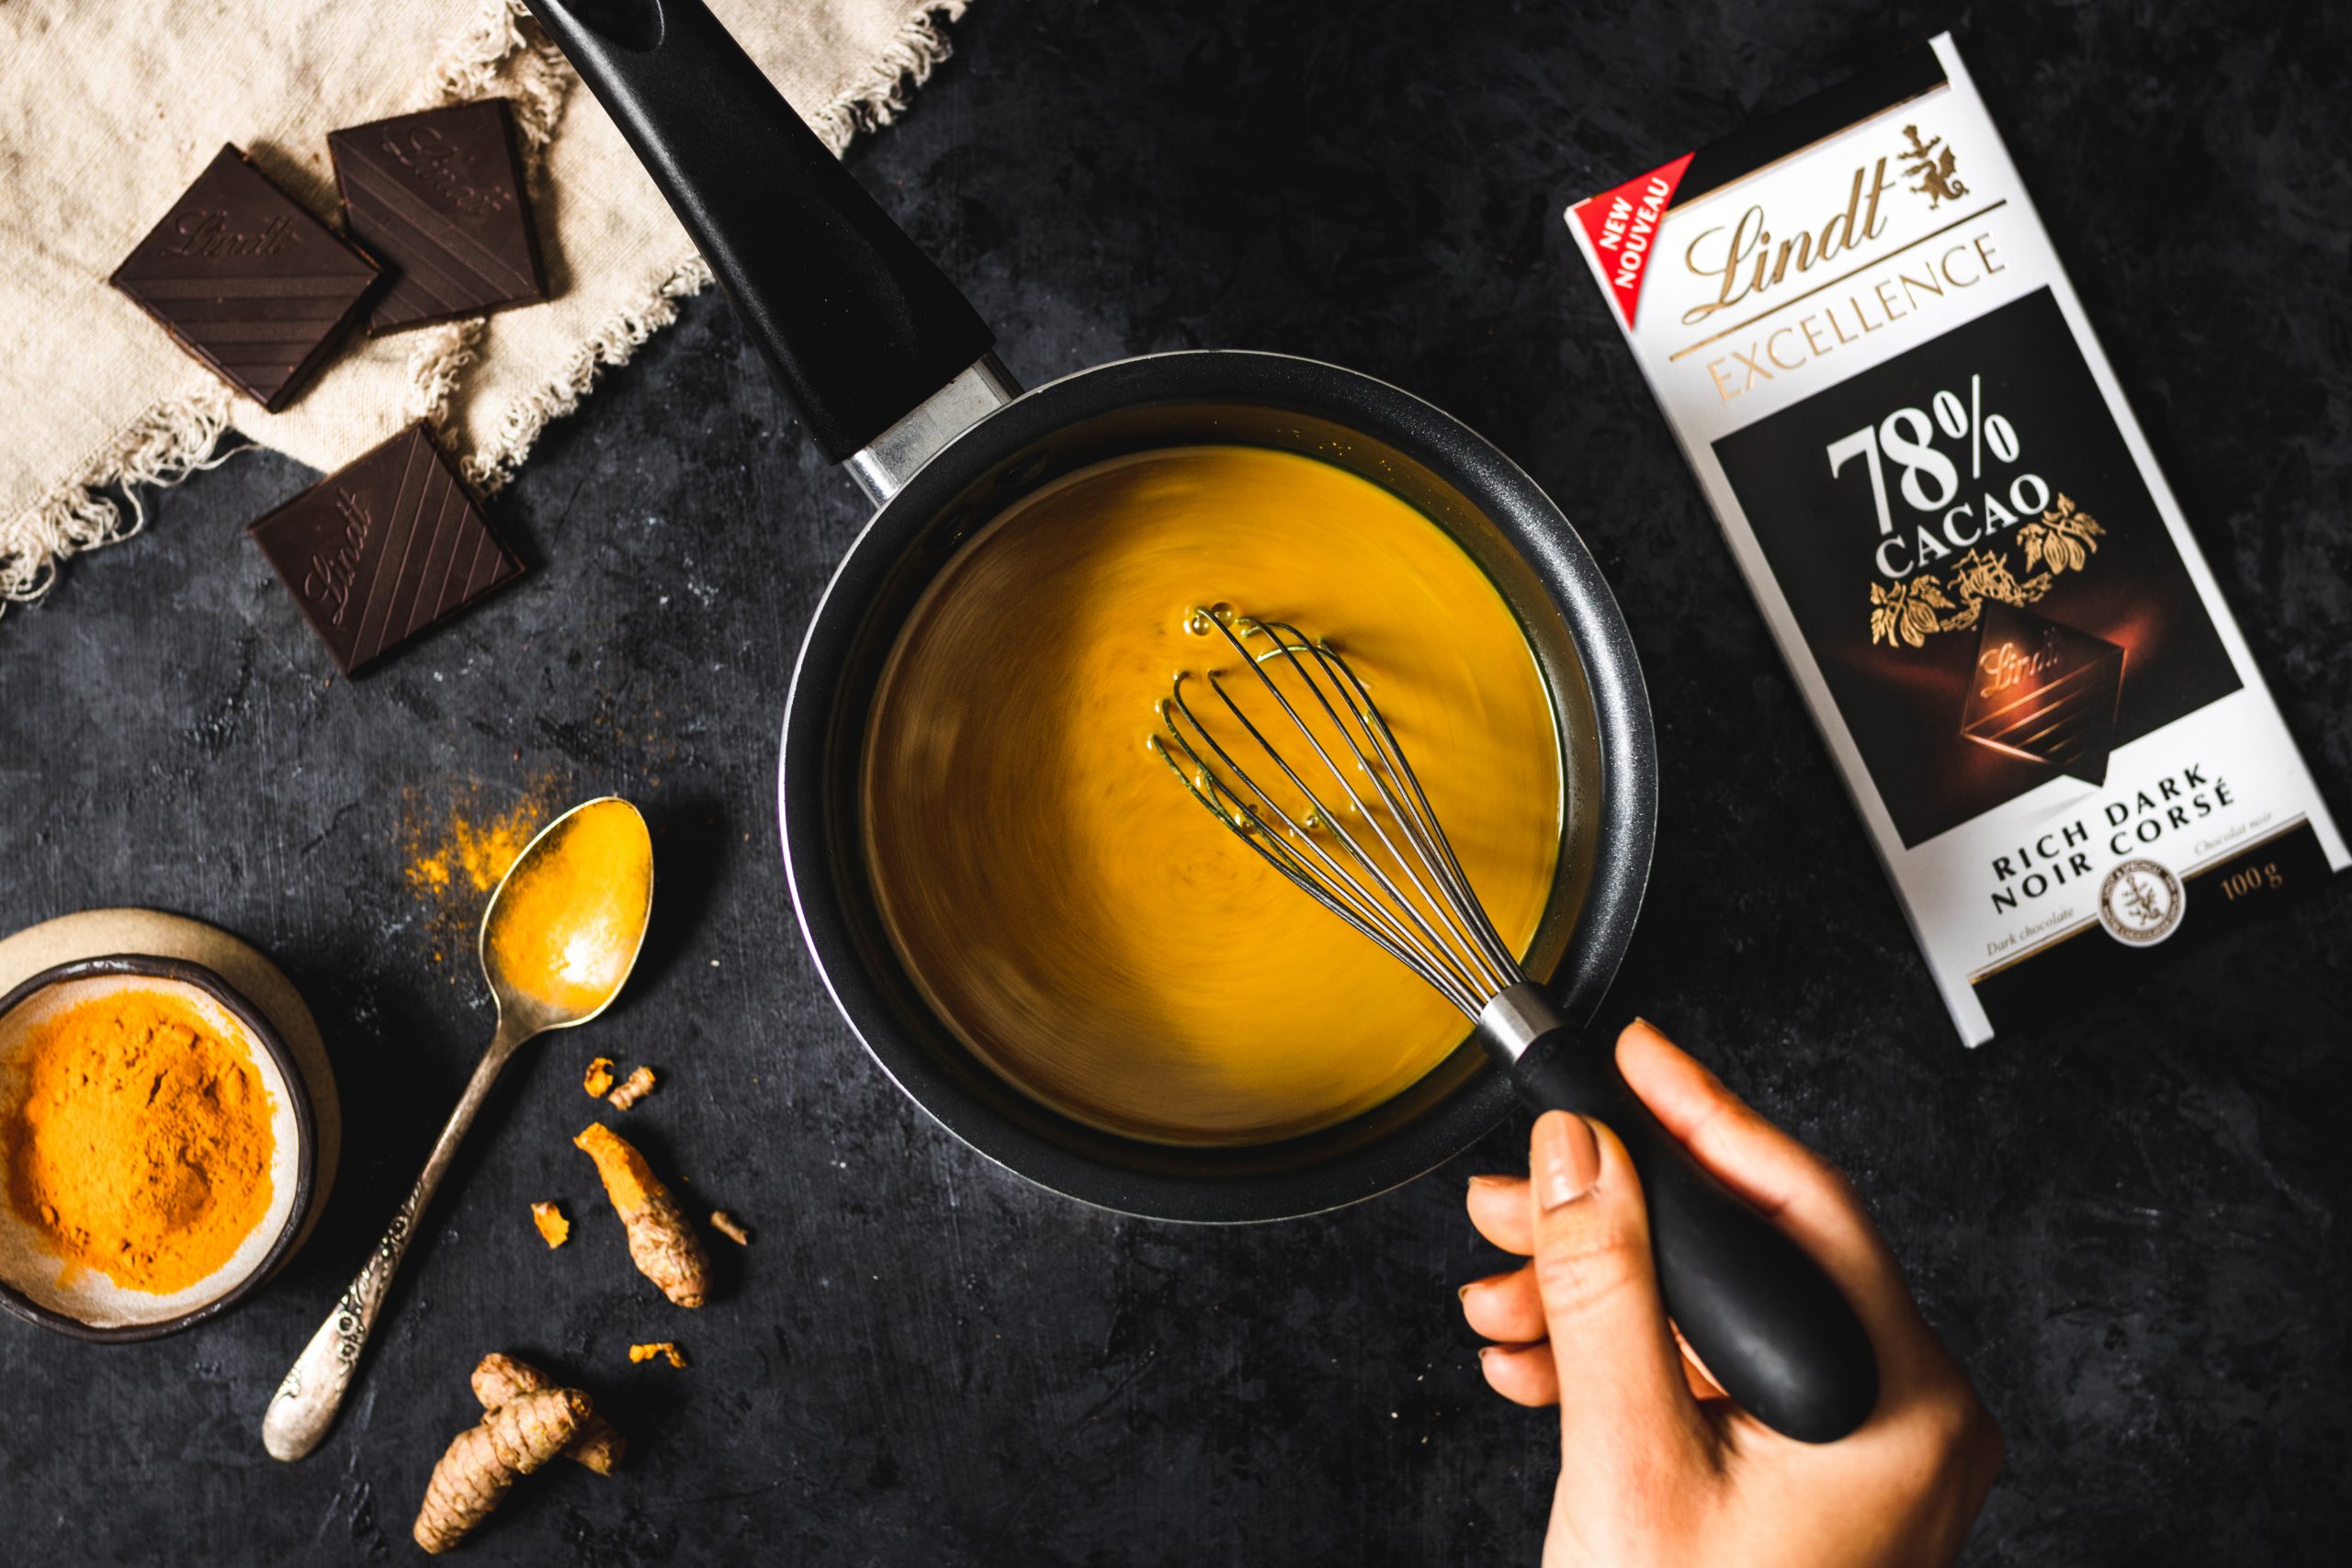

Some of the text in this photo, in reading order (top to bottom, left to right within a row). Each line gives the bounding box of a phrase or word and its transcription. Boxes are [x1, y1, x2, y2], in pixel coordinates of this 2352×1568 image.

[159, 209, 303, 259] Lindt
[1599, 197, 1634, 252] NEW
[1615, 177, 1670, 289] NOUVEAU
[1681, 156, 1896, 325] Lindt
[1706, 232, 2007, 401] EXCELLENCE
[1826, 374, 2020, 536] 78%
[303, 485, 371, 626] Lindt
[1875, 474, 2051, 579] CACAO
[1990, 852, 2094, 915] NOIR
[2109, 778, 2234, 856] CORSÉ
[1992, 762, 2209, 882] RICH DARK
[2194, 810, 2274, 856] Chocolat noir
[1986, 906, 2075, 957] Dark chocolate
[2220, 862, 2283, 902] 100 g
